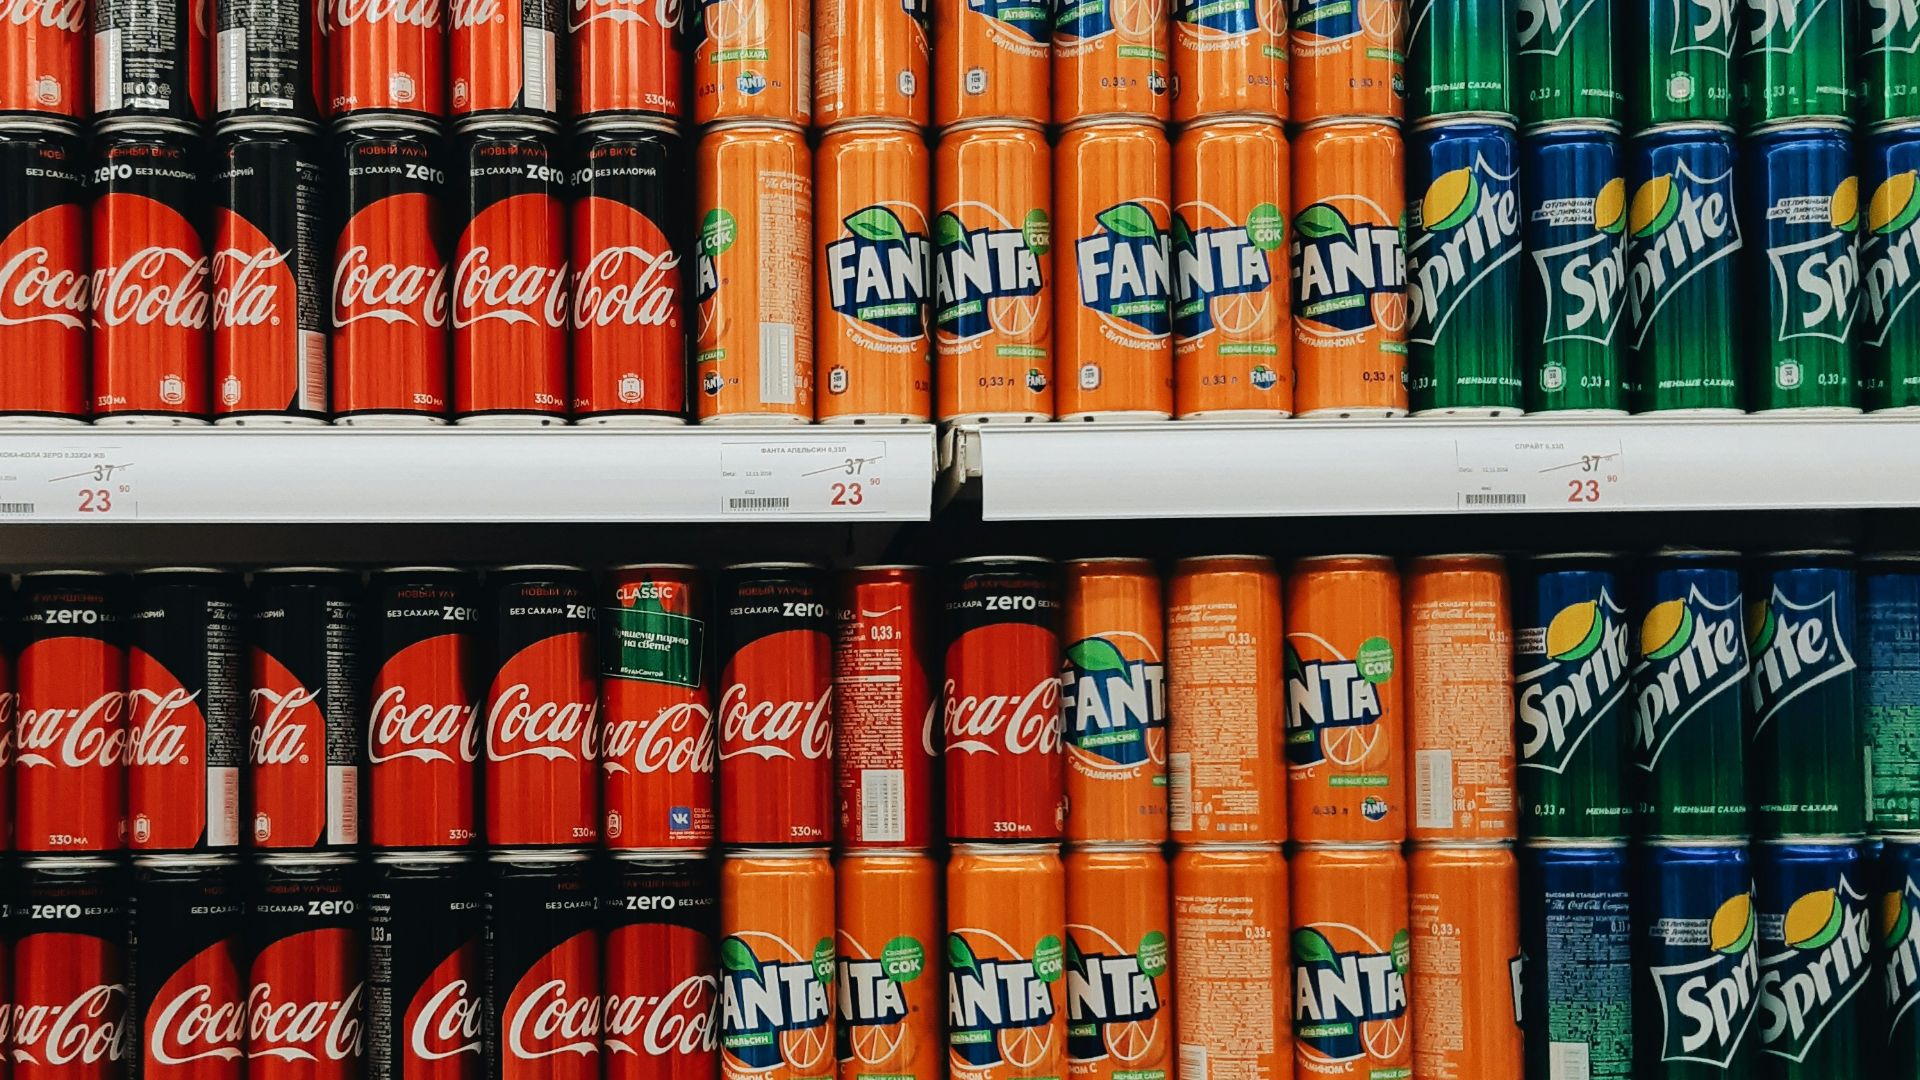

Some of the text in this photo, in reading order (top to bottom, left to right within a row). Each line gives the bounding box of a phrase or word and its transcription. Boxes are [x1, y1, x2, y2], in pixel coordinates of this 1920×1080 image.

[1467, 81, 1502, 90] САХАРА
[644, 93, 665, 105] 330
[359, 144, 398, 157] НОВЫЙ
[480, 144, 519, 157] НОВЫЙ
[609, 147, 638, 158] ВКУС
[25, 167, 44, 177] БЕЗ
[94, 163, 197, 185] zero БЕЗ КАЛОРИЙ
[349, 163, 445, 185] БЕЗ САХАРА zero
[470, 163, 565, 185] БЕЗ САХАРА zero
[595, 166, 657, 178] БЕЗ КАЛОРИЙ
[1544, 200, 1593, 209] ОТЛИЧНЫЙ
[1779, 198, 1829, 208] ОТЛИЧНЫЙ
[1792, 205, 1829, 214] ЛИМОНА
[1556, 207, 1592, 216] ЛИМОНА
[1561, 214, 1593, 223] ЛАЙМА
[705, 230, 733, 250] СОК
[1253, 227, 1282, 244] СОК
[862, 305, 914, 320] Апельсин
[1305, 298, 1361, 317] Апельсин
[852, 335, 910, 355] ВИТАМИНОМ
[1105, 331, 1161, 351] ВИТАМИНОМ
[979, 377, 1004, 389] 0,33
[1362, 371, 1386, 383] 0,33
[1456, 376, 1498, 385] МЕНЬШЕ
[1580, 375, 1601, 388] 0,33
[1818, 374, 1839, 386] 0,33
[1658, 379, 1736, 390] МЕНЬШЕ САХАРА
[413, 392, 433, 405] 330
[534, 392, 554, 405] 330
[760, 446, 827, 455] ФАНТА АПЕЛЬСИН
[1514, 442, 1544, 450] СПРАЙТ
[844, 458, 865, 475] 37
[1581, 455, 1601, 472] 37
[93, 464, 115, 482] 37
[830, 478, 881, 506] 23 90
[1567, 474, 1618, 503] 23 90
[78, 485, 131, 513] 23 90
[615, 586, 673, 601] CLASSIC
[729, 601, 825, 618] БЕЗ САХАРА zero
[985, 595, 1036, 611] zero
[45, 608, 98, 625] zero
[386, 605, 479, 622] БЕЗ САХАРА zero
[509, 606, 563, 616] БЕЗ САХАРА
[655, 632, 689, 646] парню
[870, 625, 893, 641] 0,33
[1228, 632, 1250, 646] 0,33
[623, 639, 671, 652] на свете
[1364, 661, 1392, 676] СОК
[1636, 612, 1739, 751] prite
[1082, 731, 1136, 747] Апельсин
[1073, 760, 1133, 781] ВИТАМИНОМ
[1534, 804, 1556, 816] 0,33
[1585, 807, 1621, 816] МЕНЬШЕ
[1673, 805, 1717, 815] МЕНЬШЕ
[1799, 804, 1838, 813] САХАРА
[572, 827, 589, 838] 330
[790, 826, 811, 836] 330
[993, 821, 1016, 833] 330
[49, 834, 72, 845] 330
[449, 828, 469, 840] 330
[270, 900, 355, 916] САХАРА zero
[450, 902, 465, 911] БЕЗ
[545, 902, 561, 911] БЕЗ
[626, 895, 694, 911] zero БЕЗ
[31, 904, 102, 920] zero БЕЗ
[191, 906, 209, 915] БЕЗ
[1245, 927, 1266, 940] 0,33
[1431, 923, 1453, 937] 0,33
[1671, 928, 1709, 936] ЛИМОНА
[1675, 936, 1709, 944] ЛАЙМА
[888, 958, 921, 974] СОК
[1039, 960, 1063, 975] СОК
[1144, 957, 1166, 971] СОК
[1761, 903, 1871, 1045] Sprite
[720, 965, 830, 1030] ANTA
[1300, 1025, 1349, 1036] Апельсин
[724, 1034, 769, 1046] Апельсин
